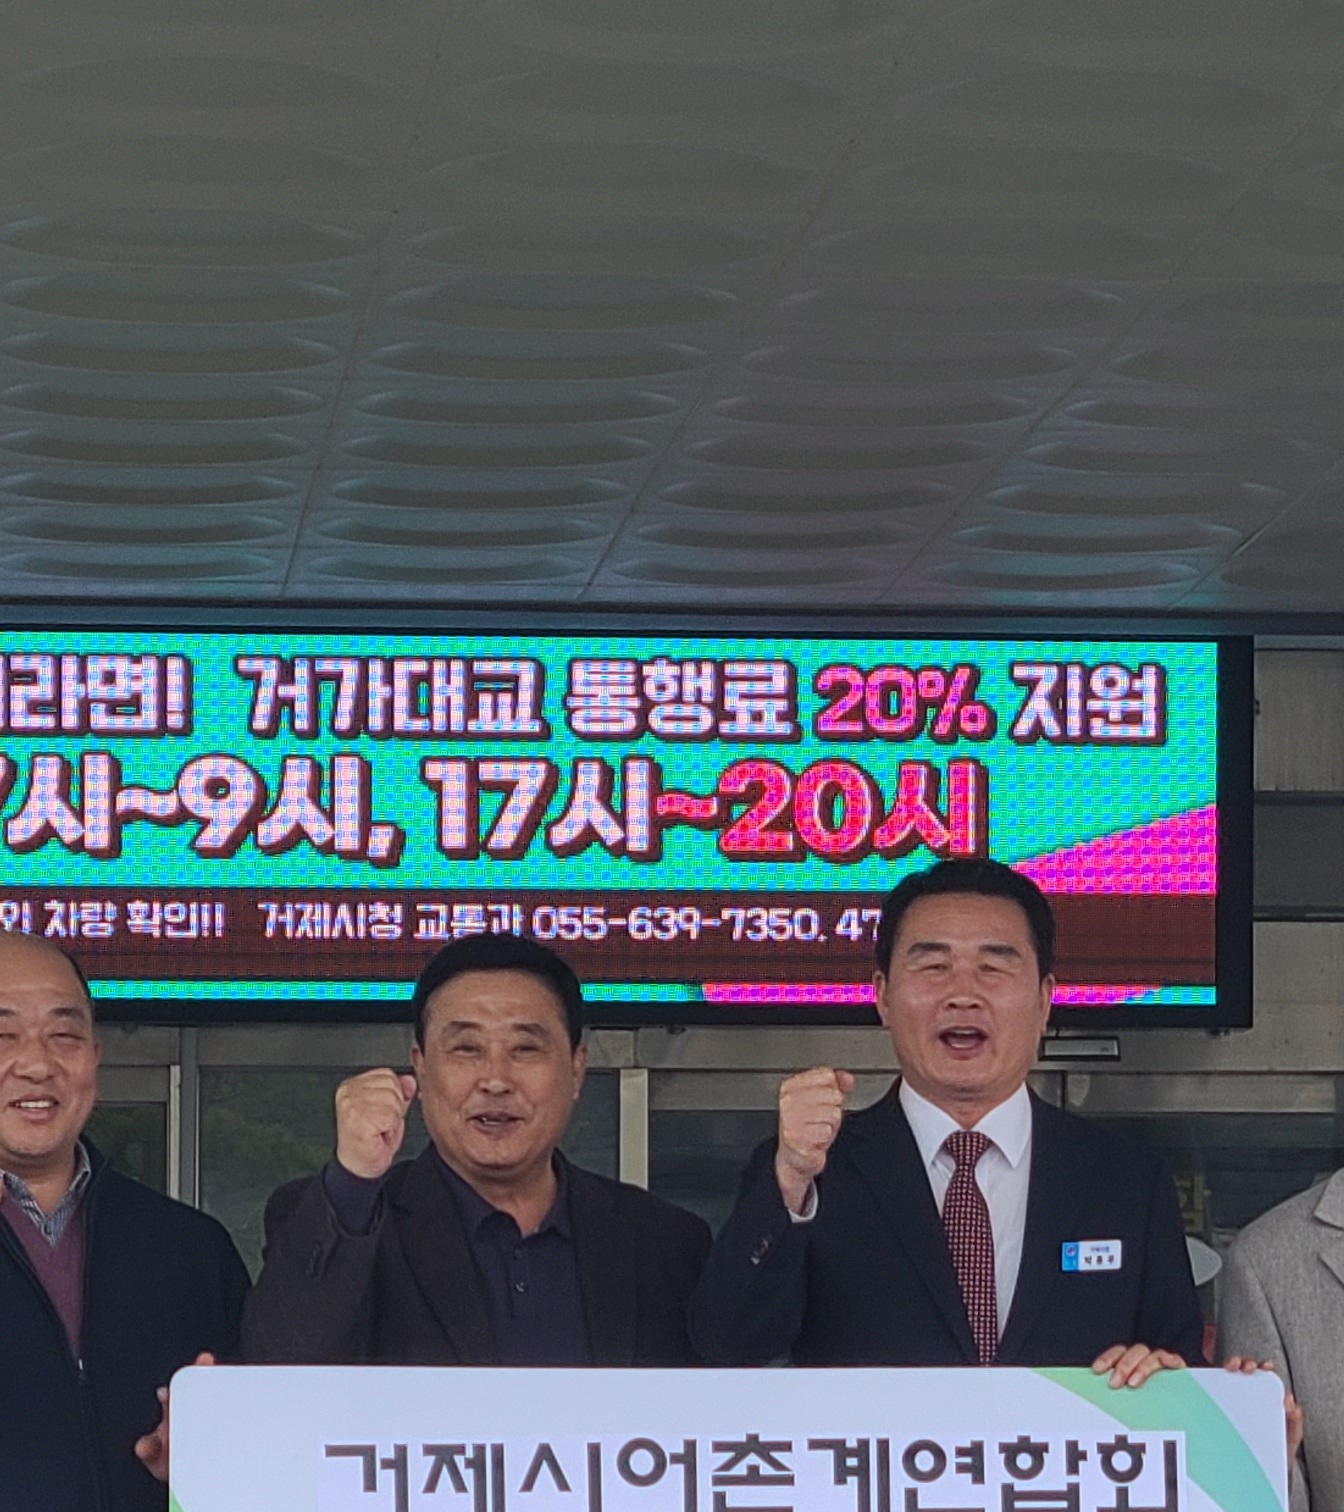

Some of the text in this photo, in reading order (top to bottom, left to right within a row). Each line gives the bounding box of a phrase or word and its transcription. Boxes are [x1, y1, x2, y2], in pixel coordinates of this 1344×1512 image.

[237, 654, 539, 735] 거가대교
[566, 659, 796, 736] 통행료
[816, 666, 988, 734] 20%
[1012, 664, 1161, 738] 지원
[423, 758, 979, 855] 17시~20시
[45, 902, 116, 940] 차량
[127, 902, 224, 938] 확인!!
[260, 902, 401, 938] 거제시청
